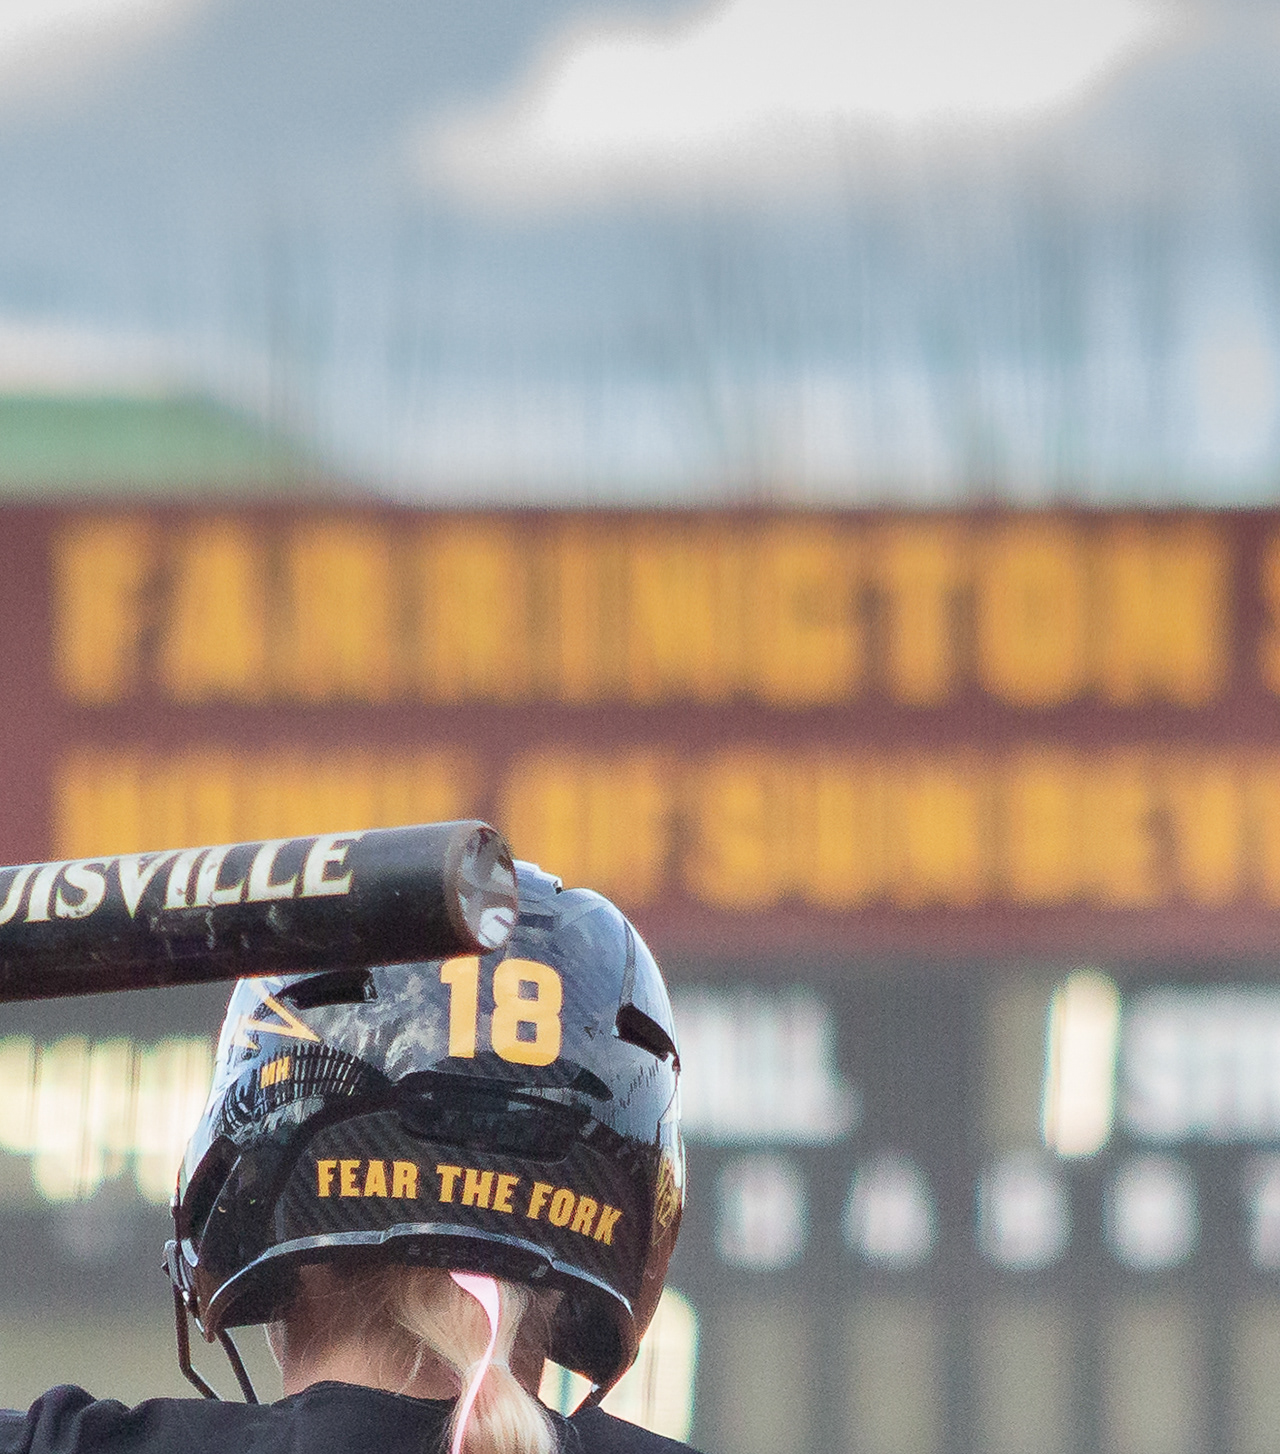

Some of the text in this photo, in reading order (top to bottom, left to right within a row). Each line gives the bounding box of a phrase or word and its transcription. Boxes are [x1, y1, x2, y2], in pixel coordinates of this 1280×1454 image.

[55, 520, 1228, 706] FARRINGTON
[686, 748, 1000, 908] SUN
[439, 955, 564, 1067] 18
[317, 1158, 418, 1201] FEAR
[435, 1163, 519, 1214] THE
[527, 1181, 624, 1246] FORK
